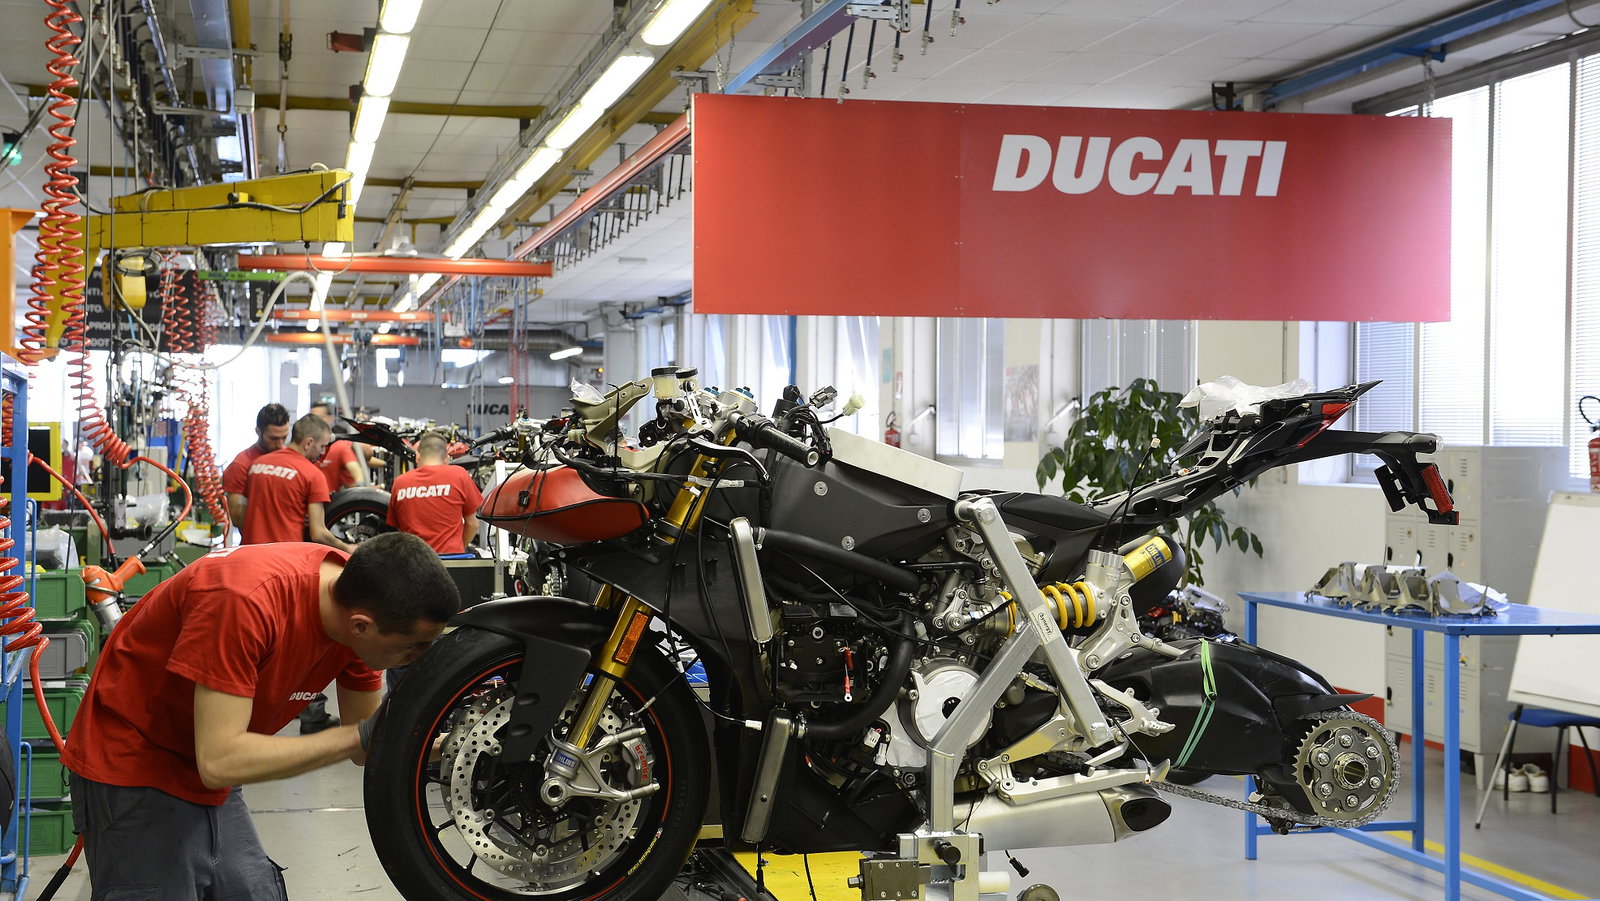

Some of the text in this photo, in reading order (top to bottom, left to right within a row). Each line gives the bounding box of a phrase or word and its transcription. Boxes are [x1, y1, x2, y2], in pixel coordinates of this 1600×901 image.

[992, 134, 1287, 197] DUCATI
[397, 484, 450, 501] DUCATI
[289, 691, 317, 701] DUCA
[635, 744, 650, 780] brembo
